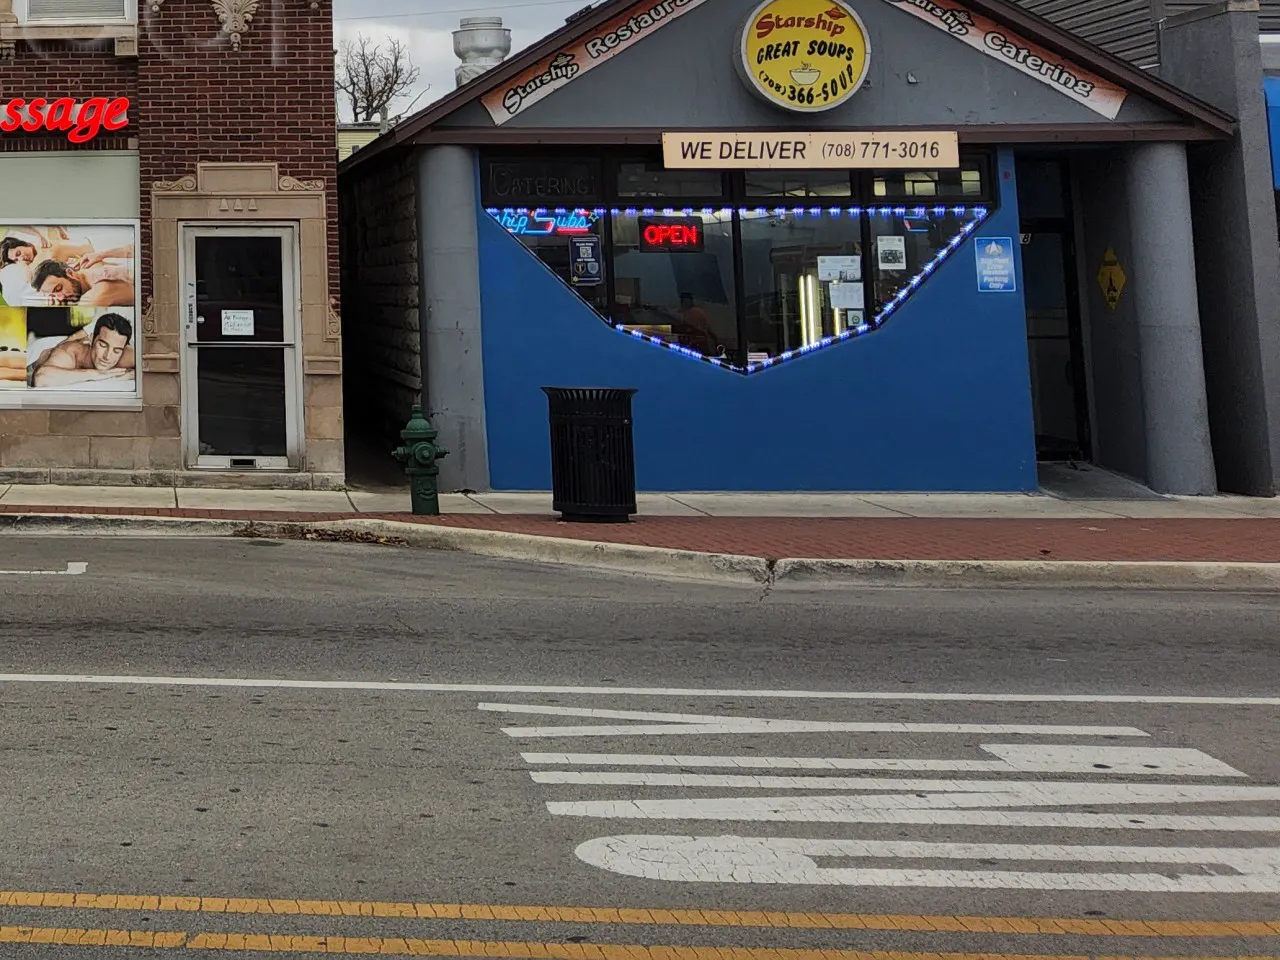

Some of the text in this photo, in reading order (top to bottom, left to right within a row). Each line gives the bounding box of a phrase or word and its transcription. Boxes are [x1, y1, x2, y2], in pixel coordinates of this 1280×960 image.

[755, 13, 846, 39] Starship
[756, 39, 855, 65] GREAT SOUPS
[983, 31, 1095, 98] Catering
[503, 62, 580, 115] Starship
[758, 63, 854, 105] (708) 366-SOUP
[680, 141, 940, 160] WE DELIVER (708) 771-3016
[643, 224, 697, 244] OPEN
